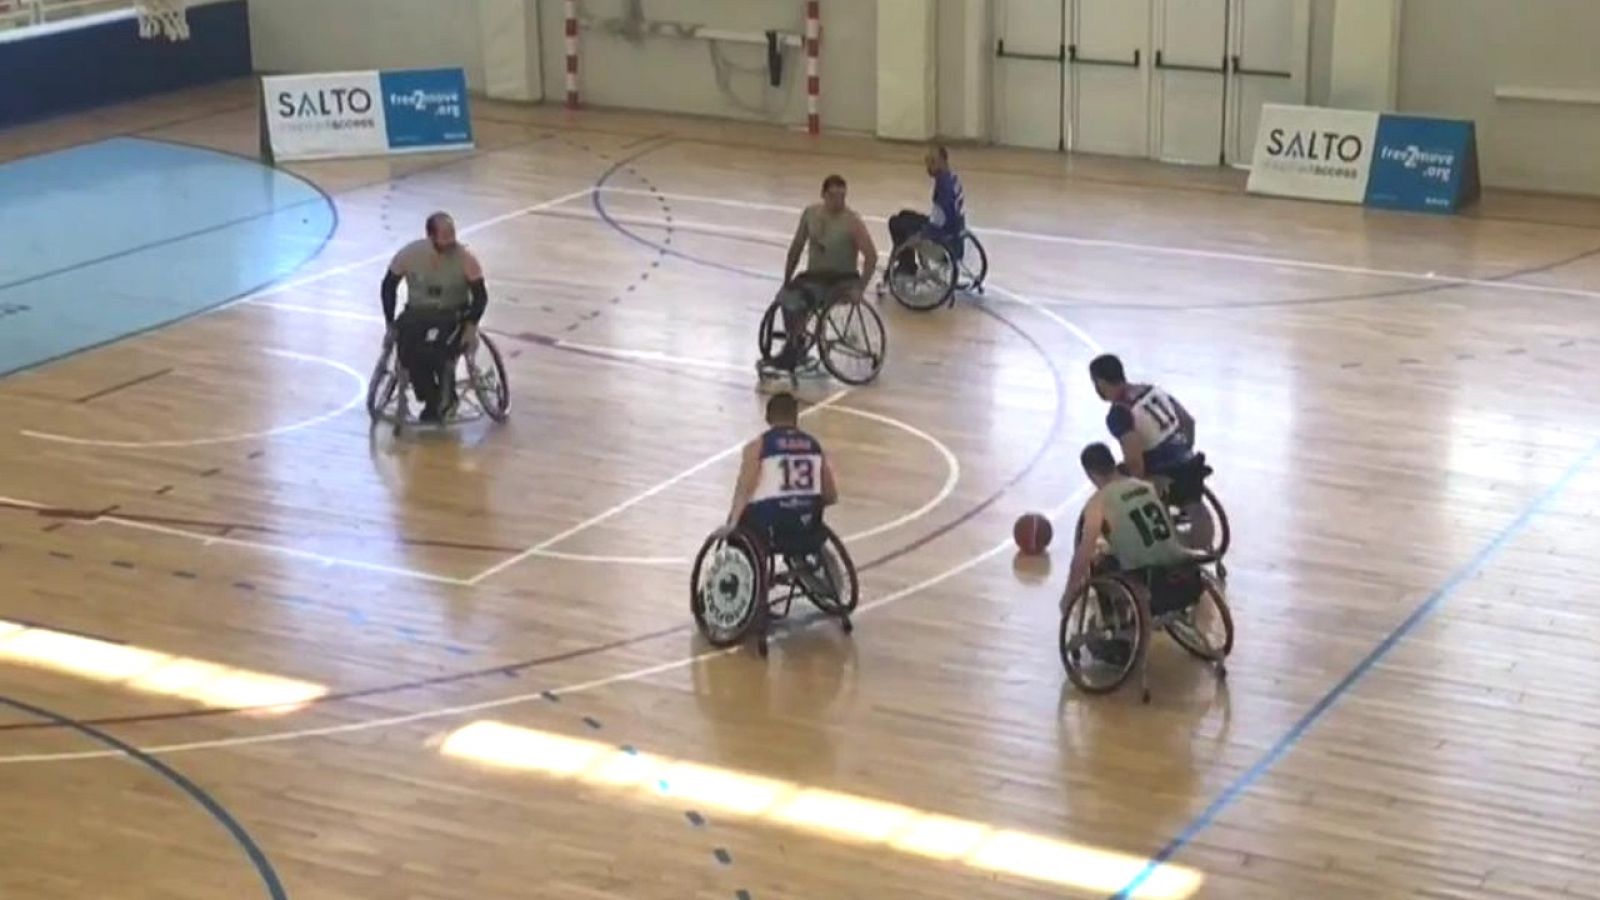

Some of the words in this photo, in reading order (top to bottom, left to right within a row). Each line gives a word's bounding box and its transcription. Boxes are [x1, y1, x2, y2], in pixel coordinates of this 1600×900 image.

[279, 87, 371, 117] SALTO
[1266, 129, 1362, 162] SALTO
[1381, 145, 1454, 169] free2move
[1422, 166, 1451, 182] .org
[777, 459, 814, 491] 13
[1129, 501, 1171, 547] 13
